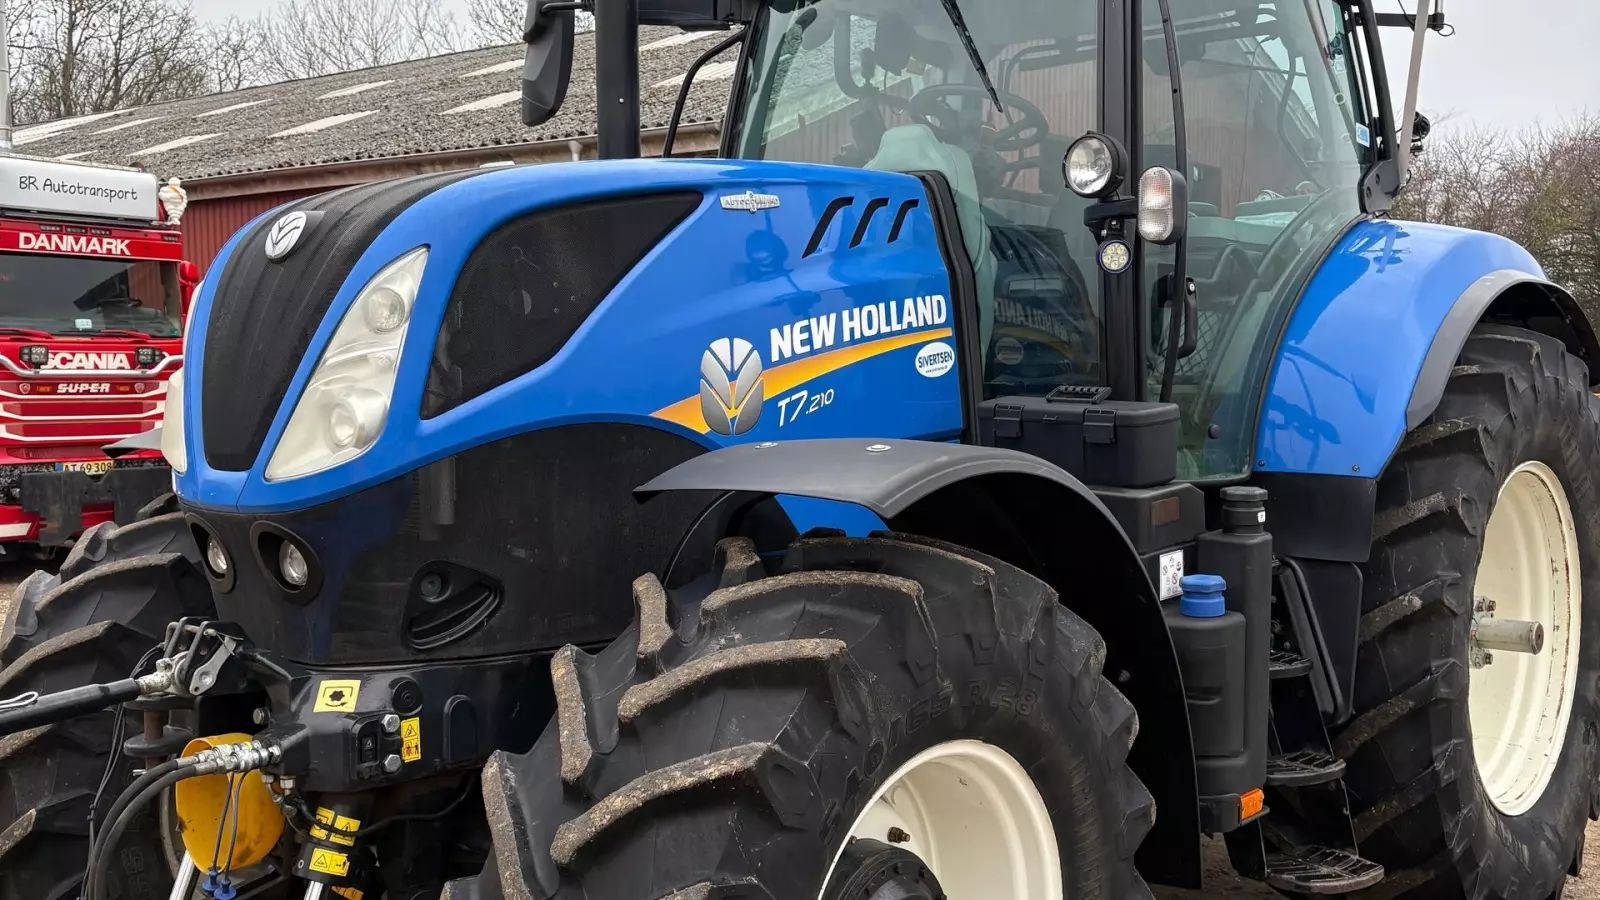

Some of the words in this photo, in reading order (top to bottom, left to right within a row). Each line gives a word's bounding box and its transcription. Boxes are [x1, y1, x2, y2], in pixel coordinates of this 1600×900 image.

[19, 175, 39, 191] BR
[42, 178, 138, 203] Autotransport
[18, 231, 131, 256] DANMARK
[769, 312, 837, 363] NEW
[842, 294, 948, 342] HOLLAND
[917, 350, 953, 369] SIVERTSEN
[57, 383, 111, 393] SUPER
[777, 388, 835, 428] T7.210
